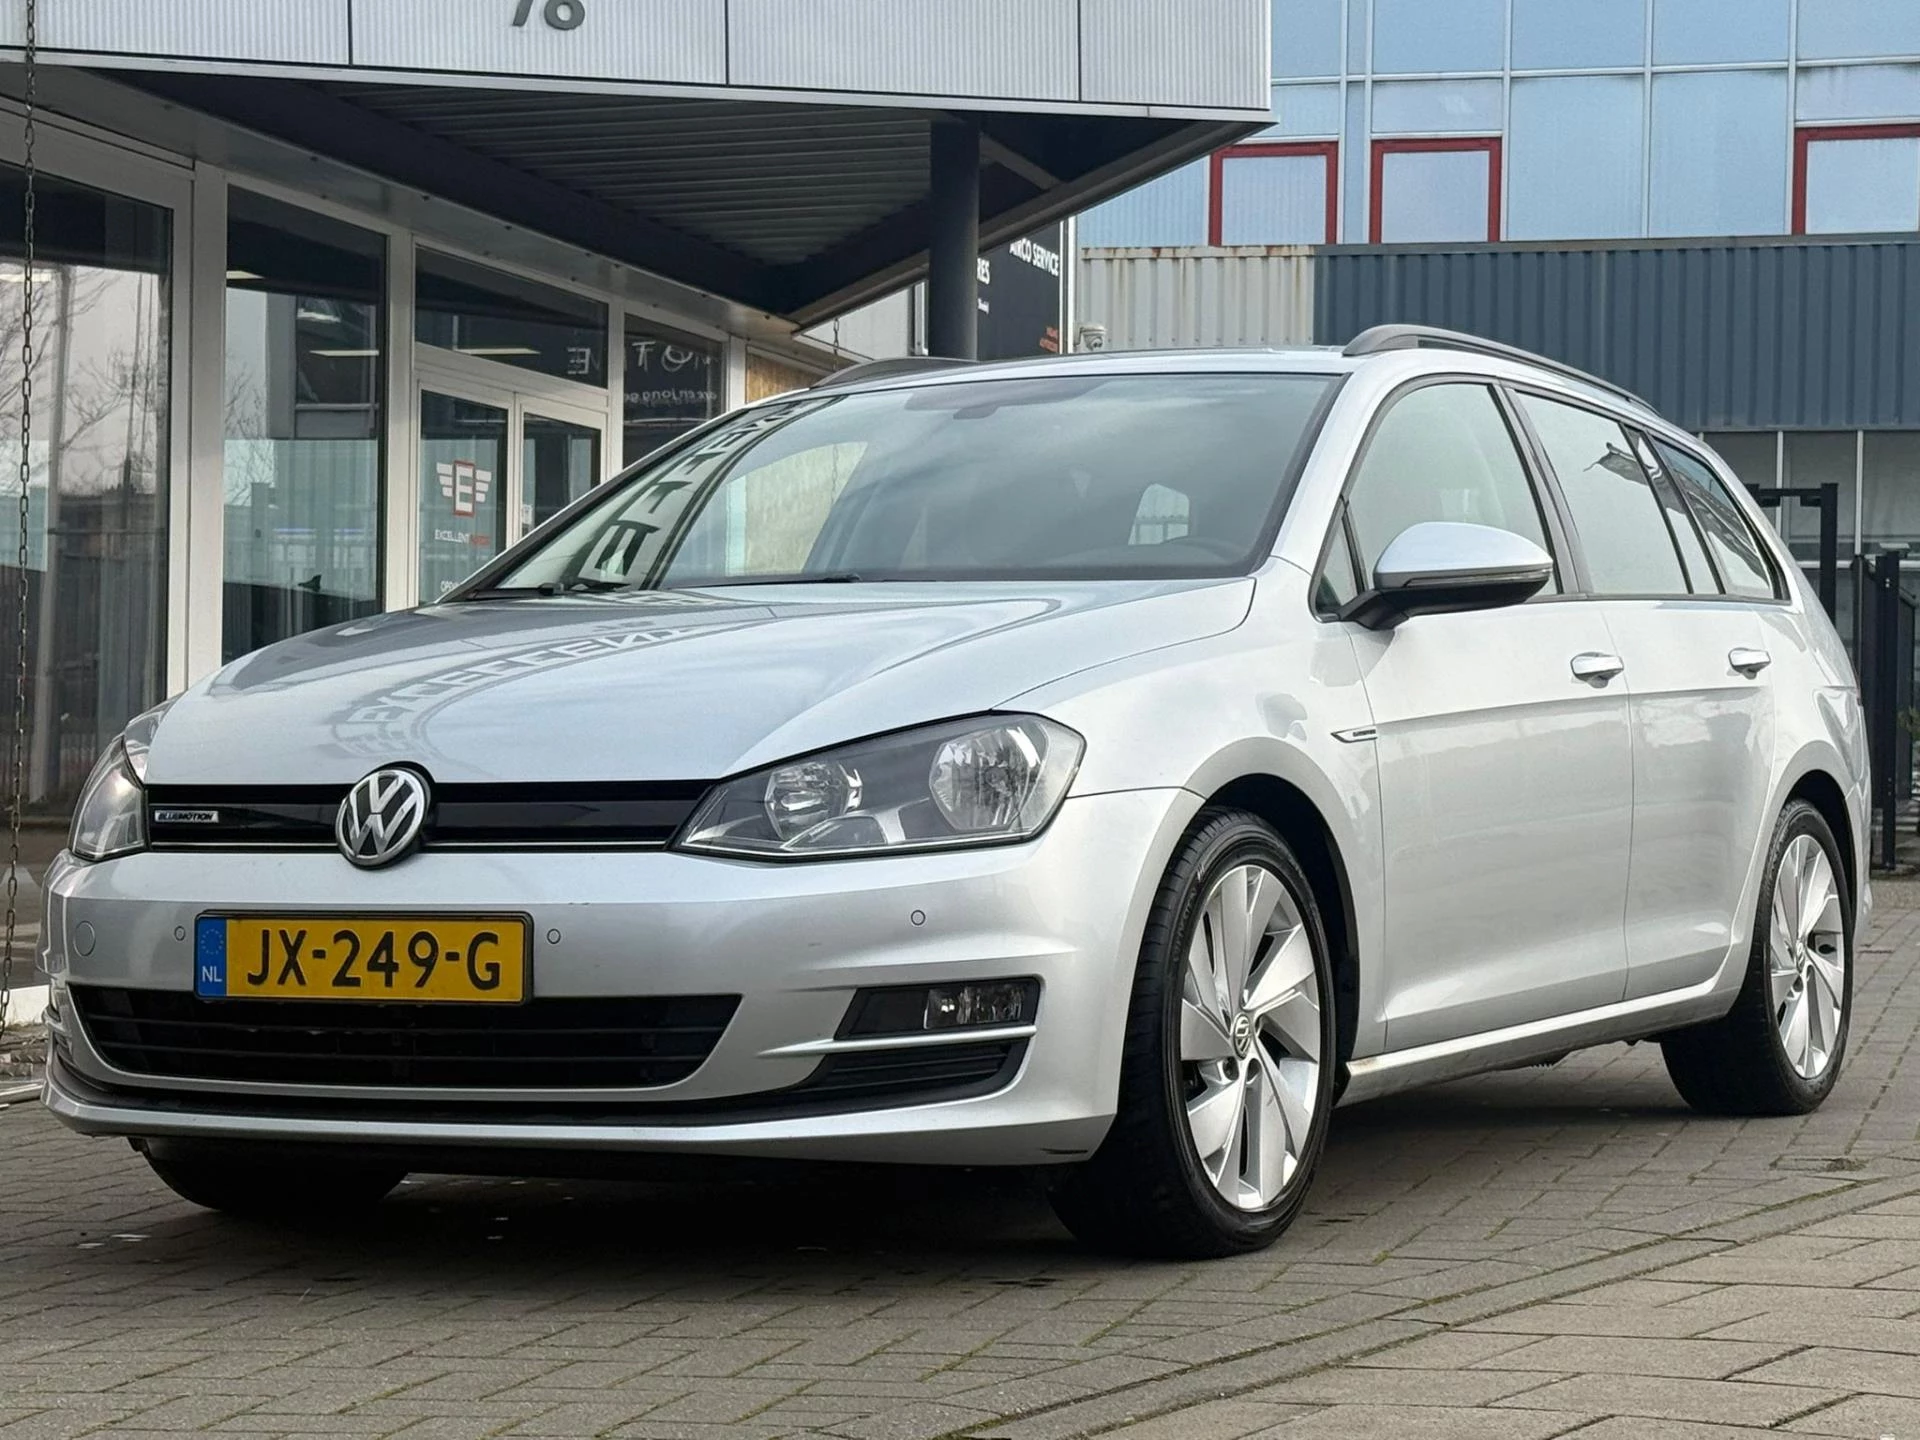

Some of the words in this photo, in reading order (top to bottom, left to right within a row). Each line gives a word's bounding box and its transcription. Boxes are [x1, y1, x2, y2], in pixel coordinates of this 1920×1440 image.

[976, 257, 990, 285] RES
[1032, 244, 1059, 276] SERVICE
[202, 965, 223, 983] NL
[247, 928, 501, 991] JX-249-G
